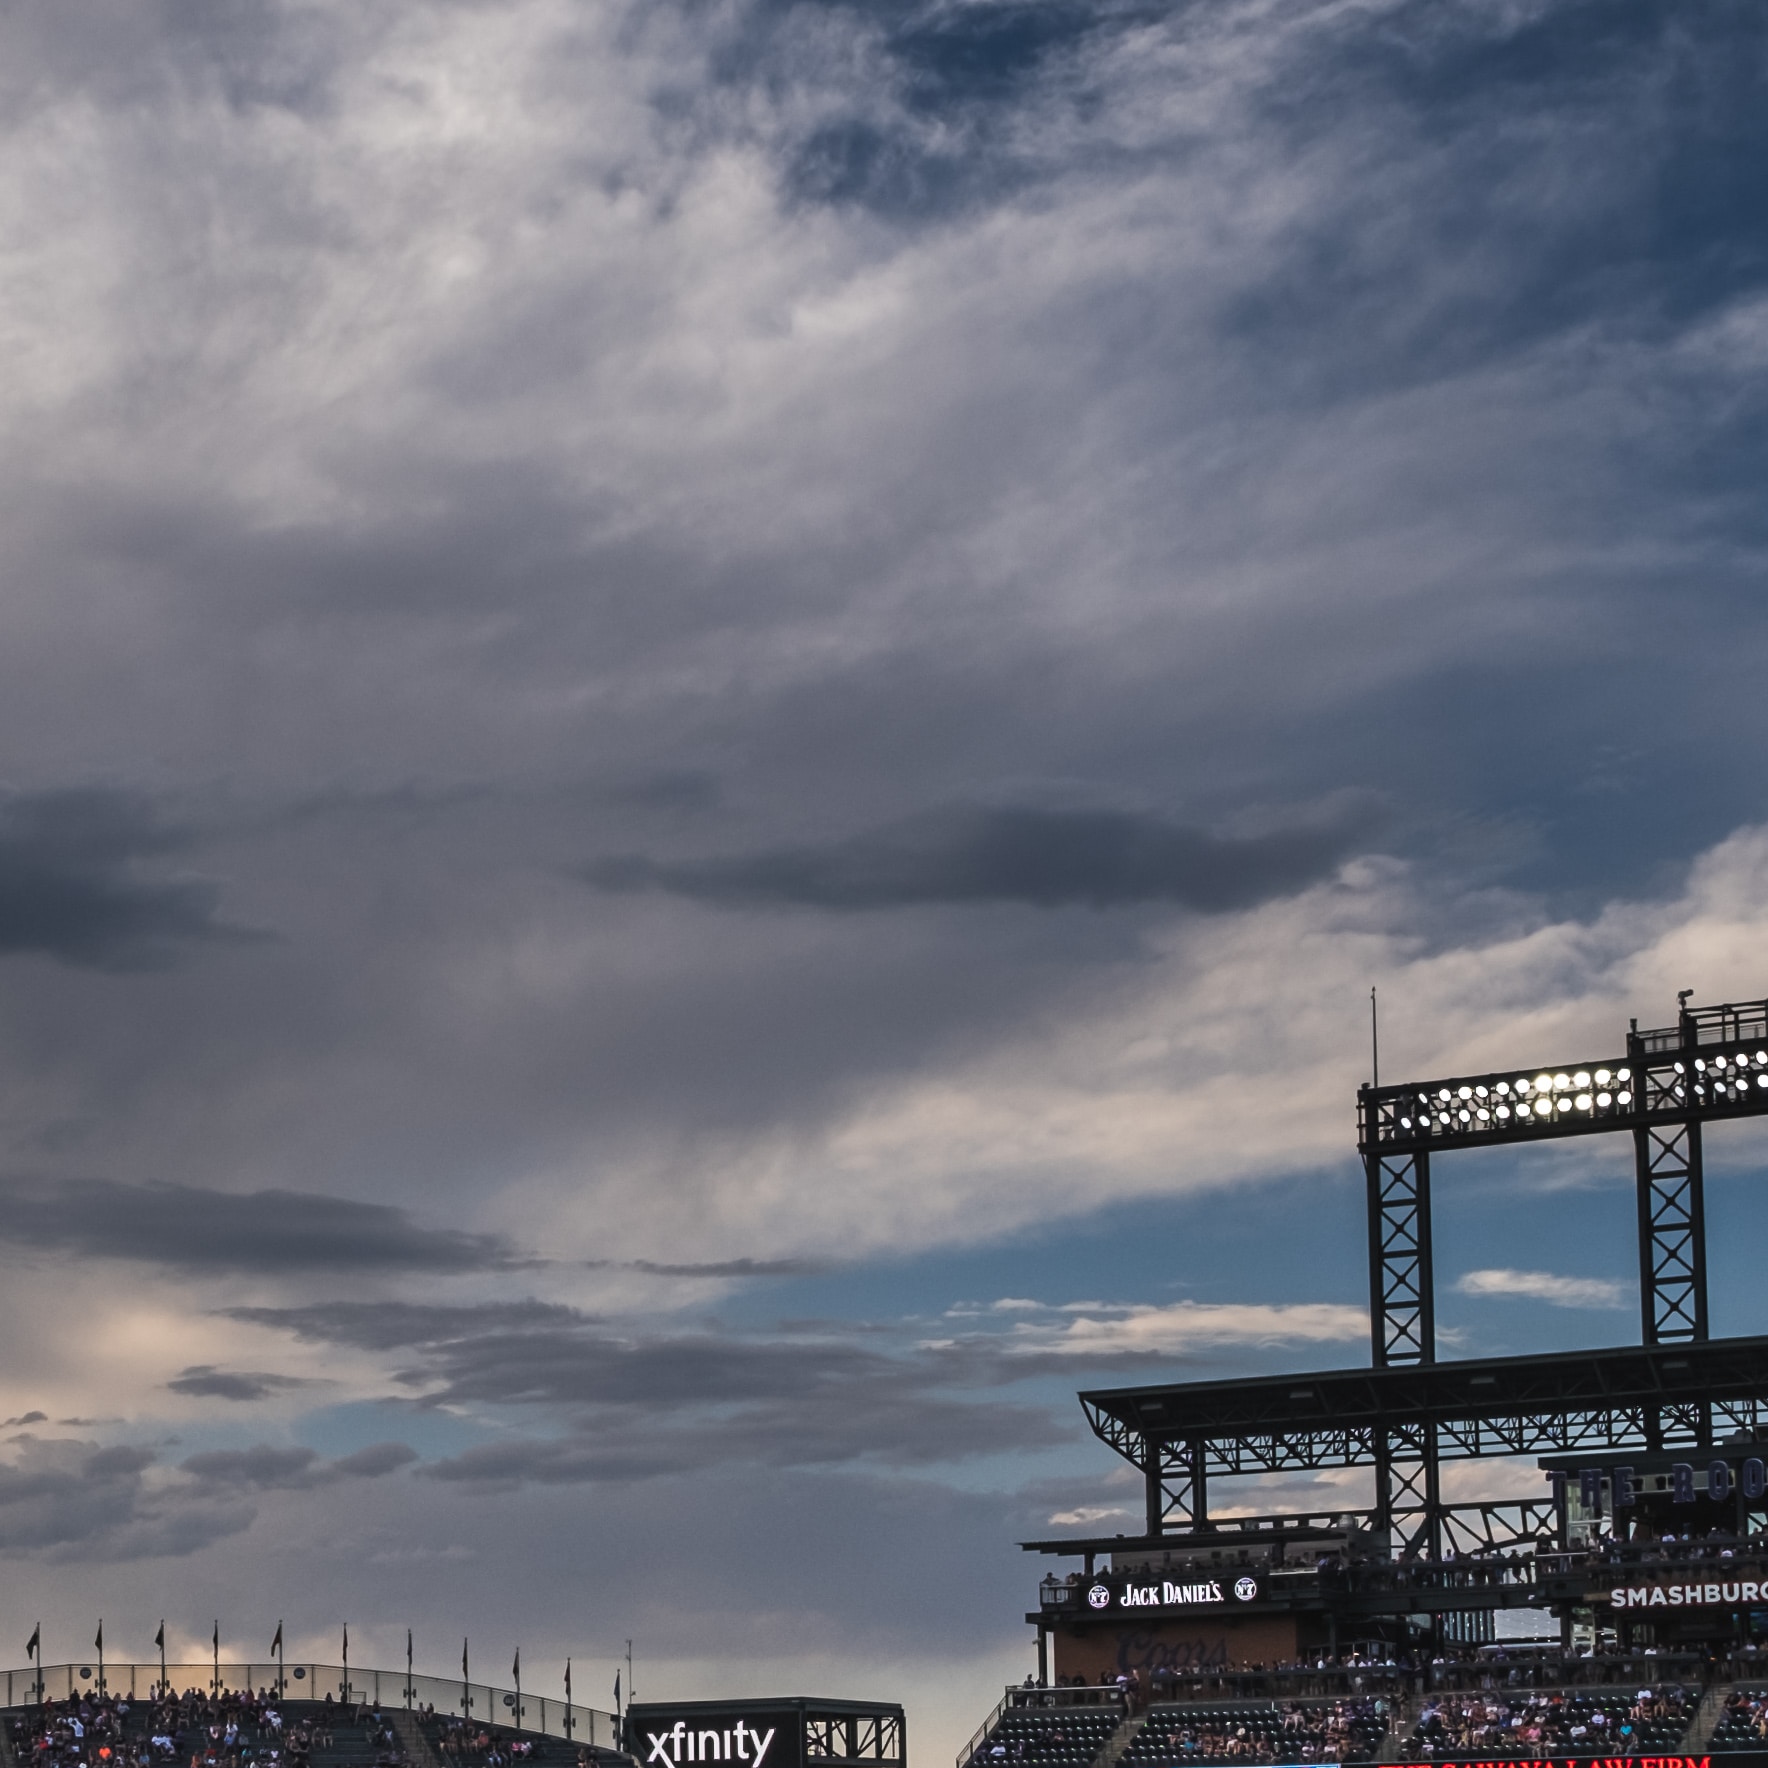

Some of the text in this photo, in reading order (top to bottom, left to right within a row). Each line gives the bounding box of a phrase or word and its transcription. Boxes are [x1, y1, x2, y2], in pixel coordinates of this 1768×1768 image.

[1547, 1466, 1635, 1510] THE
[1120, 1580, 1224, 1606] JACK DANIEL'S
[1118, 1630, 1227, 1670] Coors
